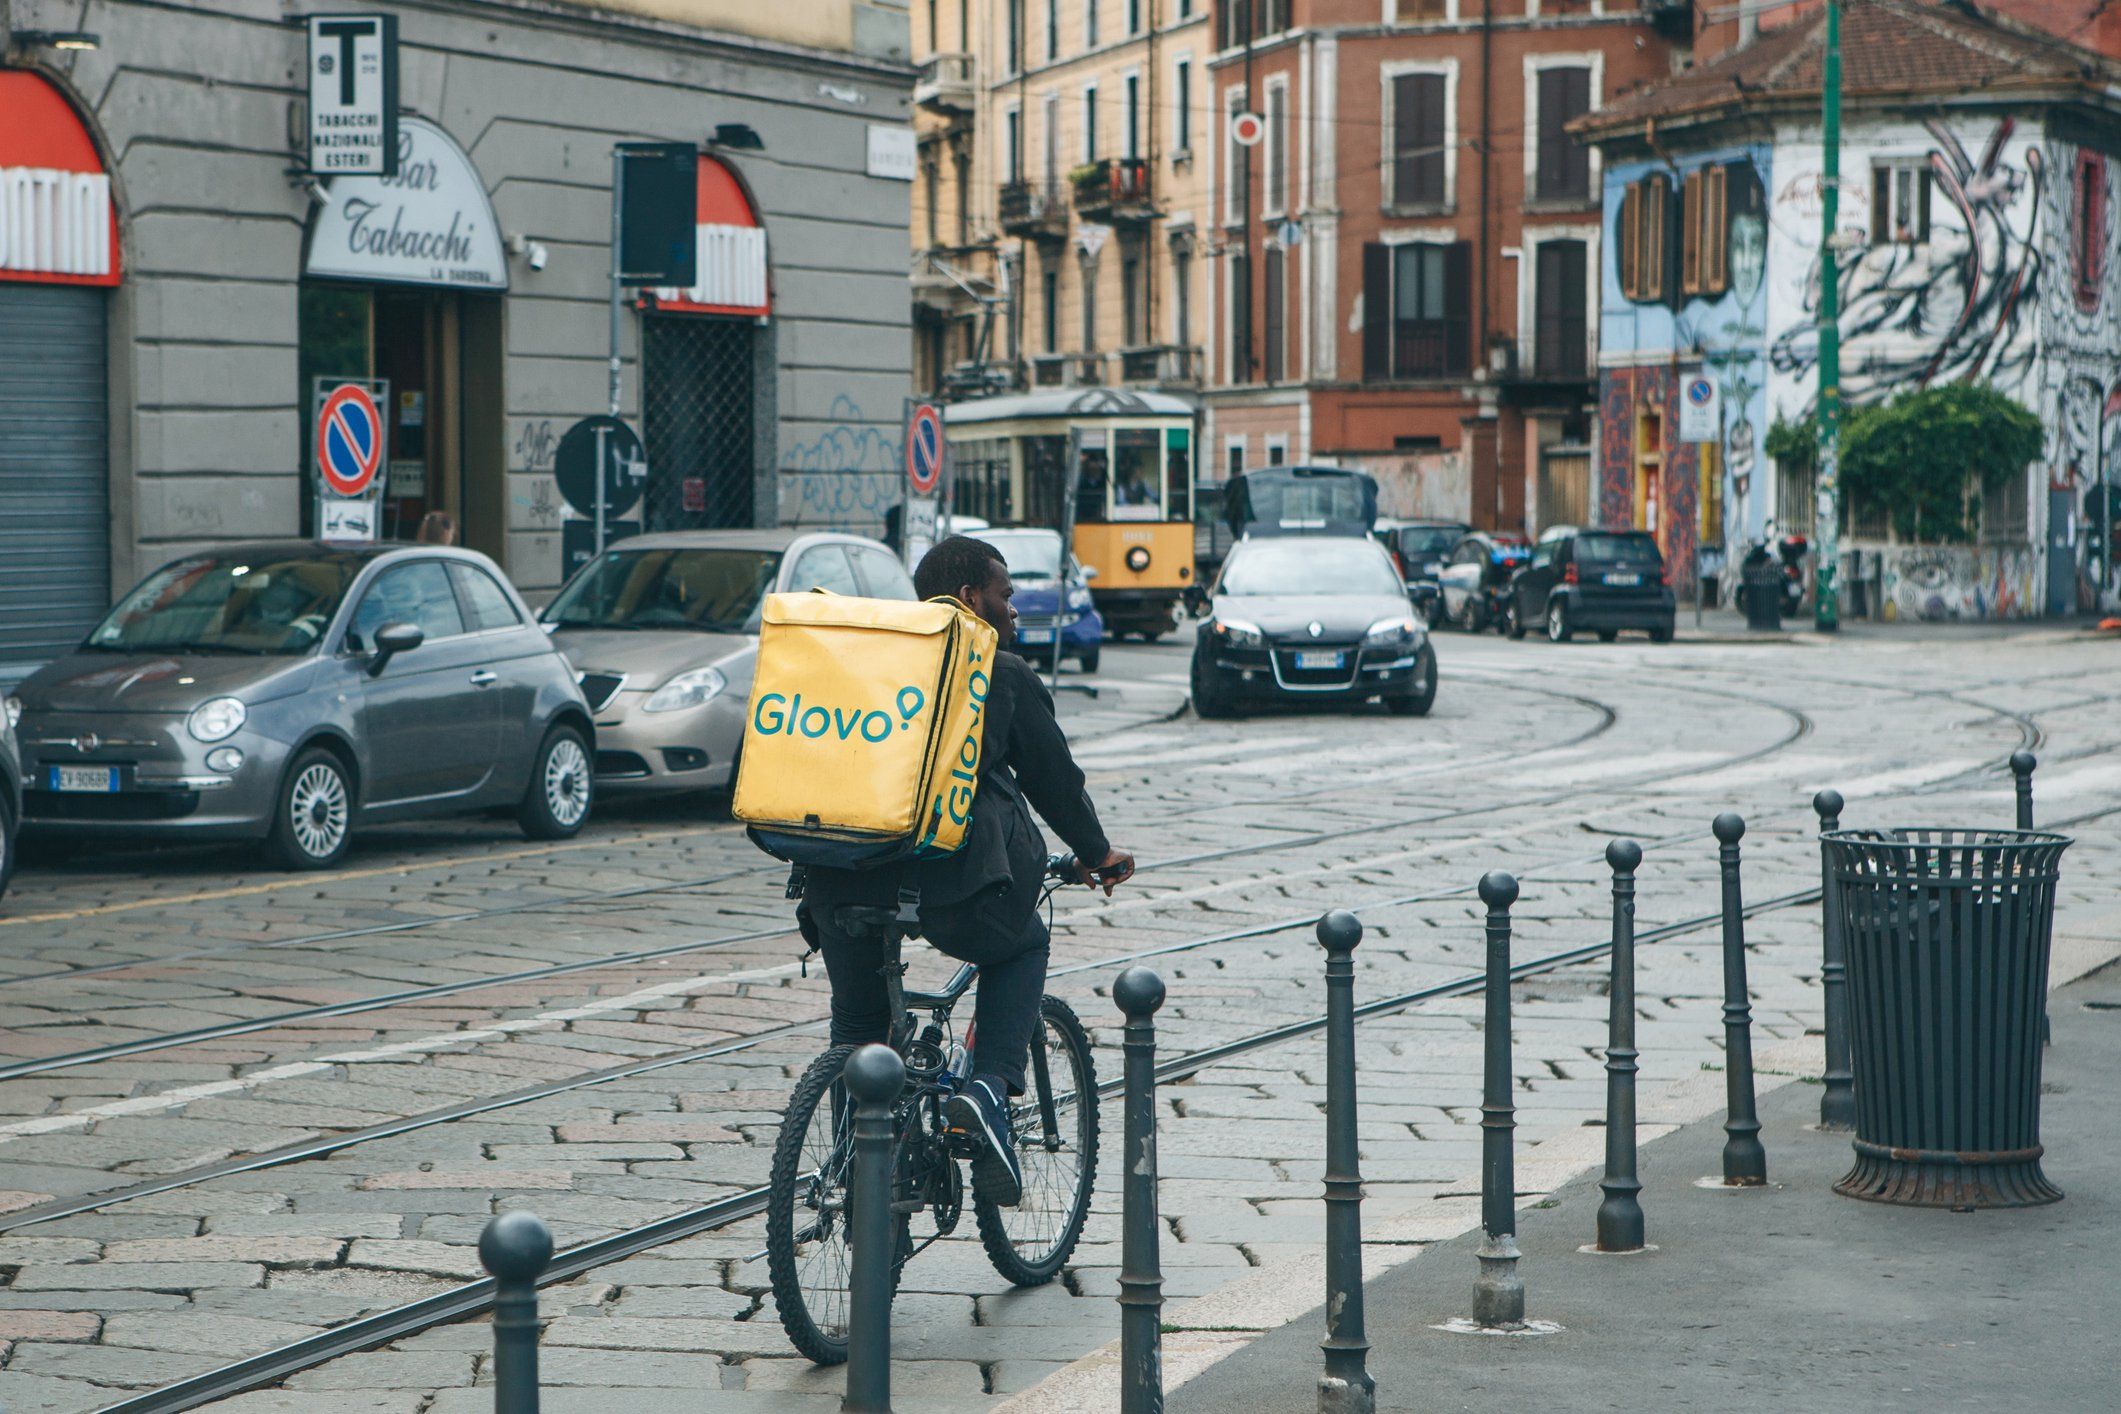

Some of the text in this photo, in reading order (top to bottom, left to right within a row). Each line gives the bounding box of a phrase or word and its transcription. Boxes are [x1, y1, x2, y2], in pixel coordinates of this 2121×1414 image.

[319, 21, 376, 105] T
[318, 114, 378, 127] TABACCHI
[314, 134, 382, 147] NAZIONALI
[325, 154, 371, 167] ESTERI
[343, 197, 474, 262] Tabacchi
[754, 692, 893, 743] Glovo
